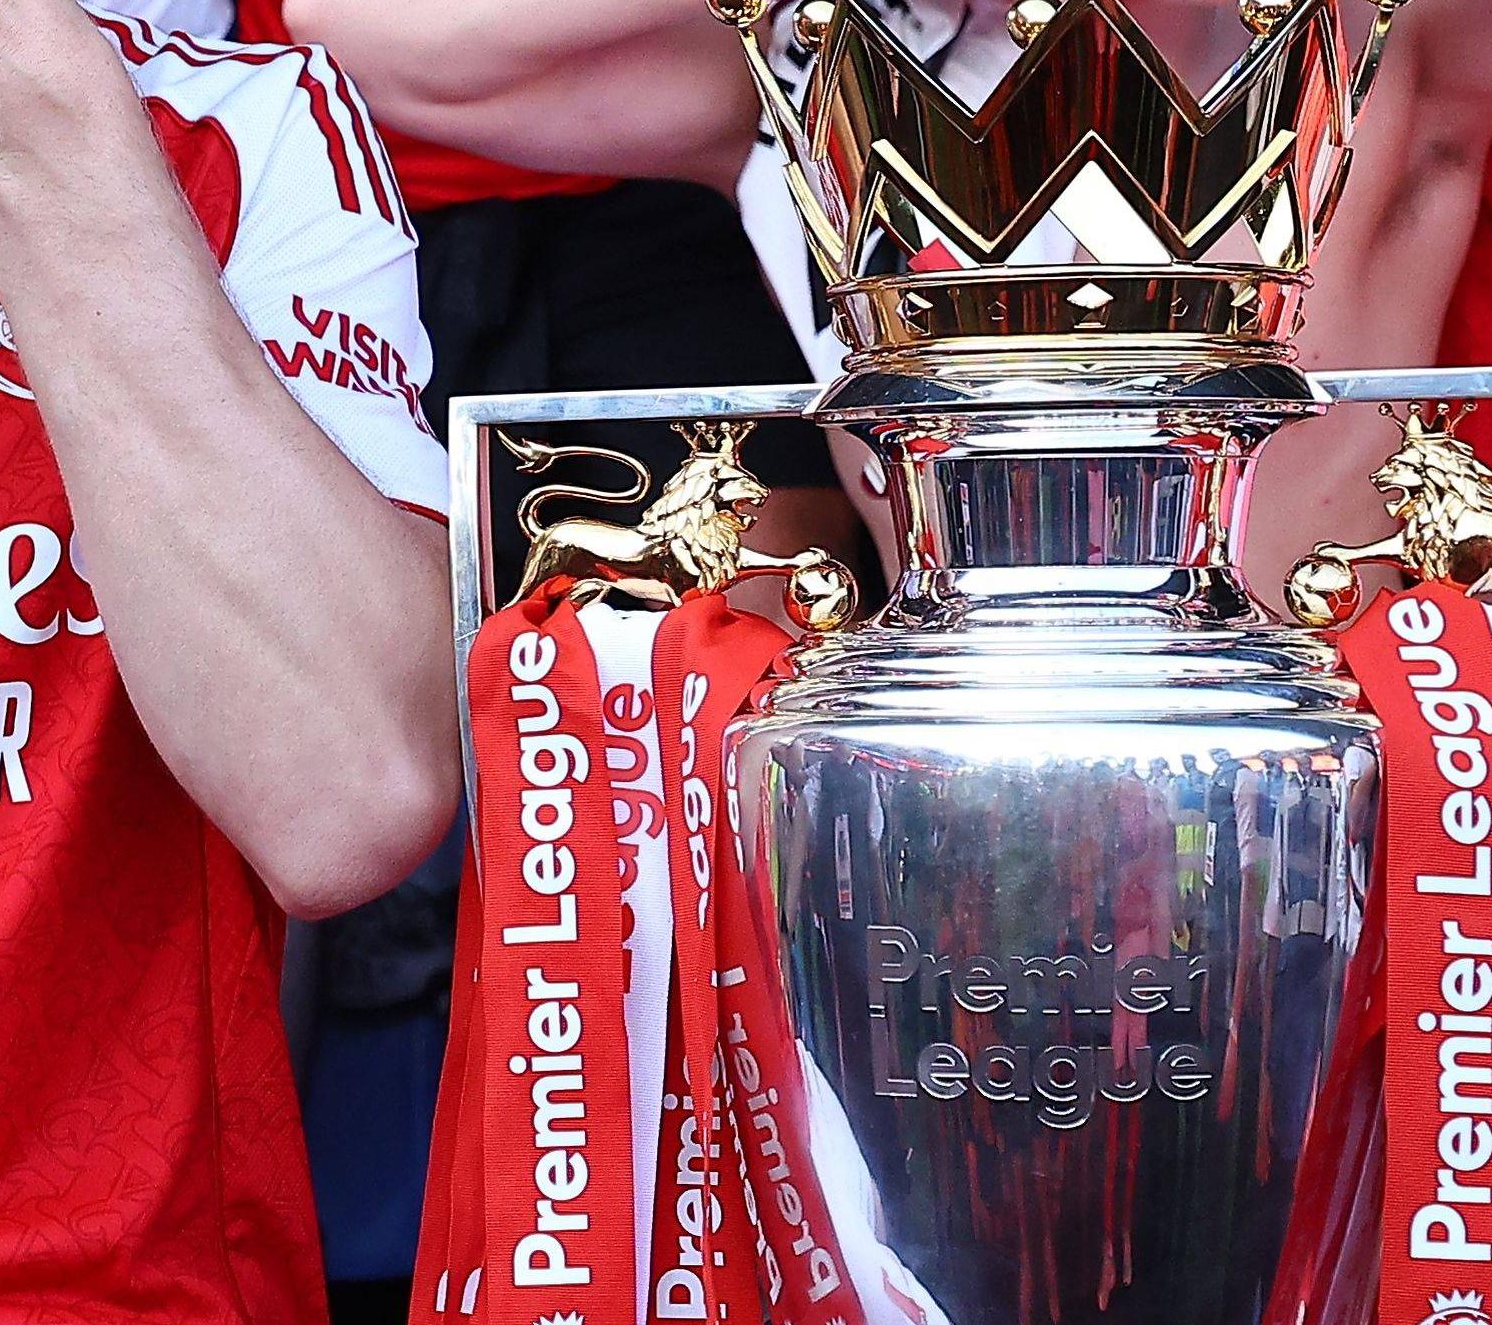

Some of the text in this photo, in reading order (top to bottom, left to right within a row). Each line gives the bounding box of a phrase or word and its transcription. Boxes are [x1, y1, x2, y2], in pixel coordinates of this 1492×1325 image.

[291, 294, 408, 390] VISIT
[602, 682, 666, 995] ague
[502, 630, 591, 1289] Premier League
[866, 924, 1207, 1017] Premier
[867, 1012, 1213, 1131] League
[655, 1055, 726, 1319] Premi
